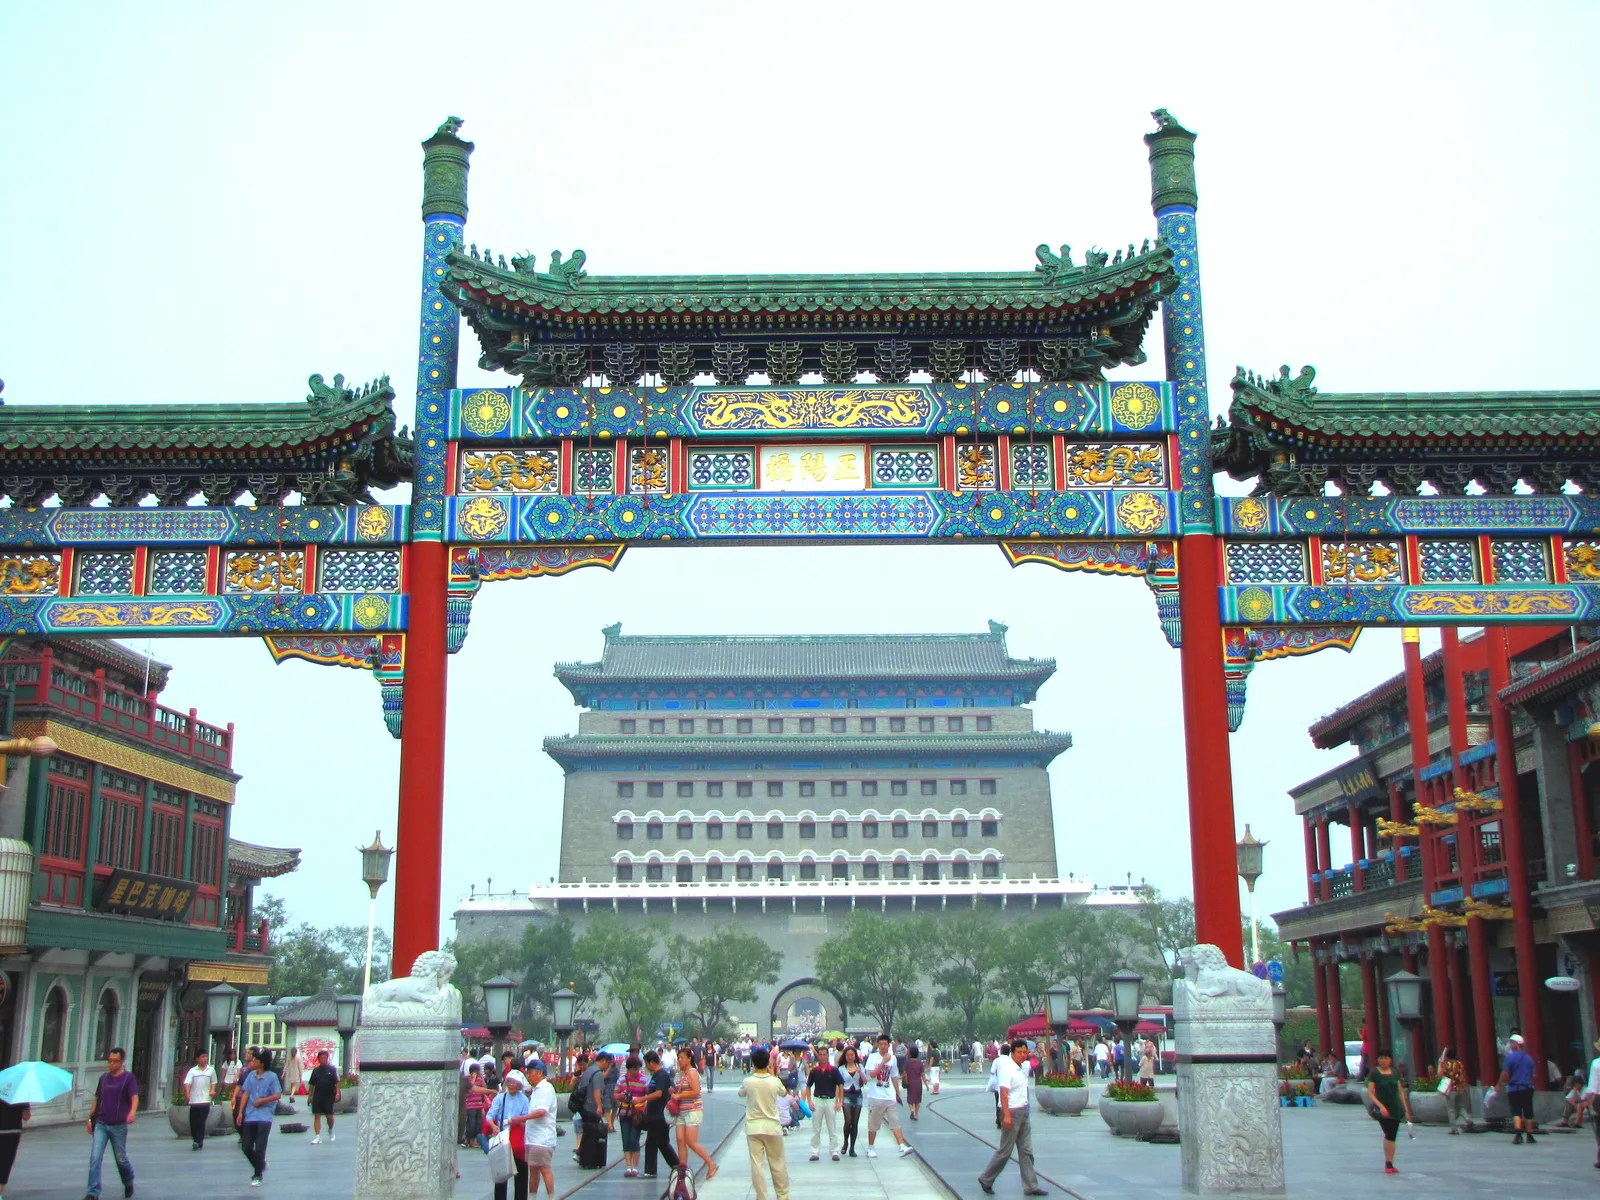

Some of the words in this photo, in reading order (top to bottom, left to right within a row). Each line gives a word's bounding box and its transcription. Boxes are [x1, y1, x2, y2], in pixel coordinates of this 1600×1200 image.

[766, 452, 860, 482] 正陽橋
[108, 878, 191, 913] 星巴克咖啡
[139, 992, 160, 1001] COFFEE
